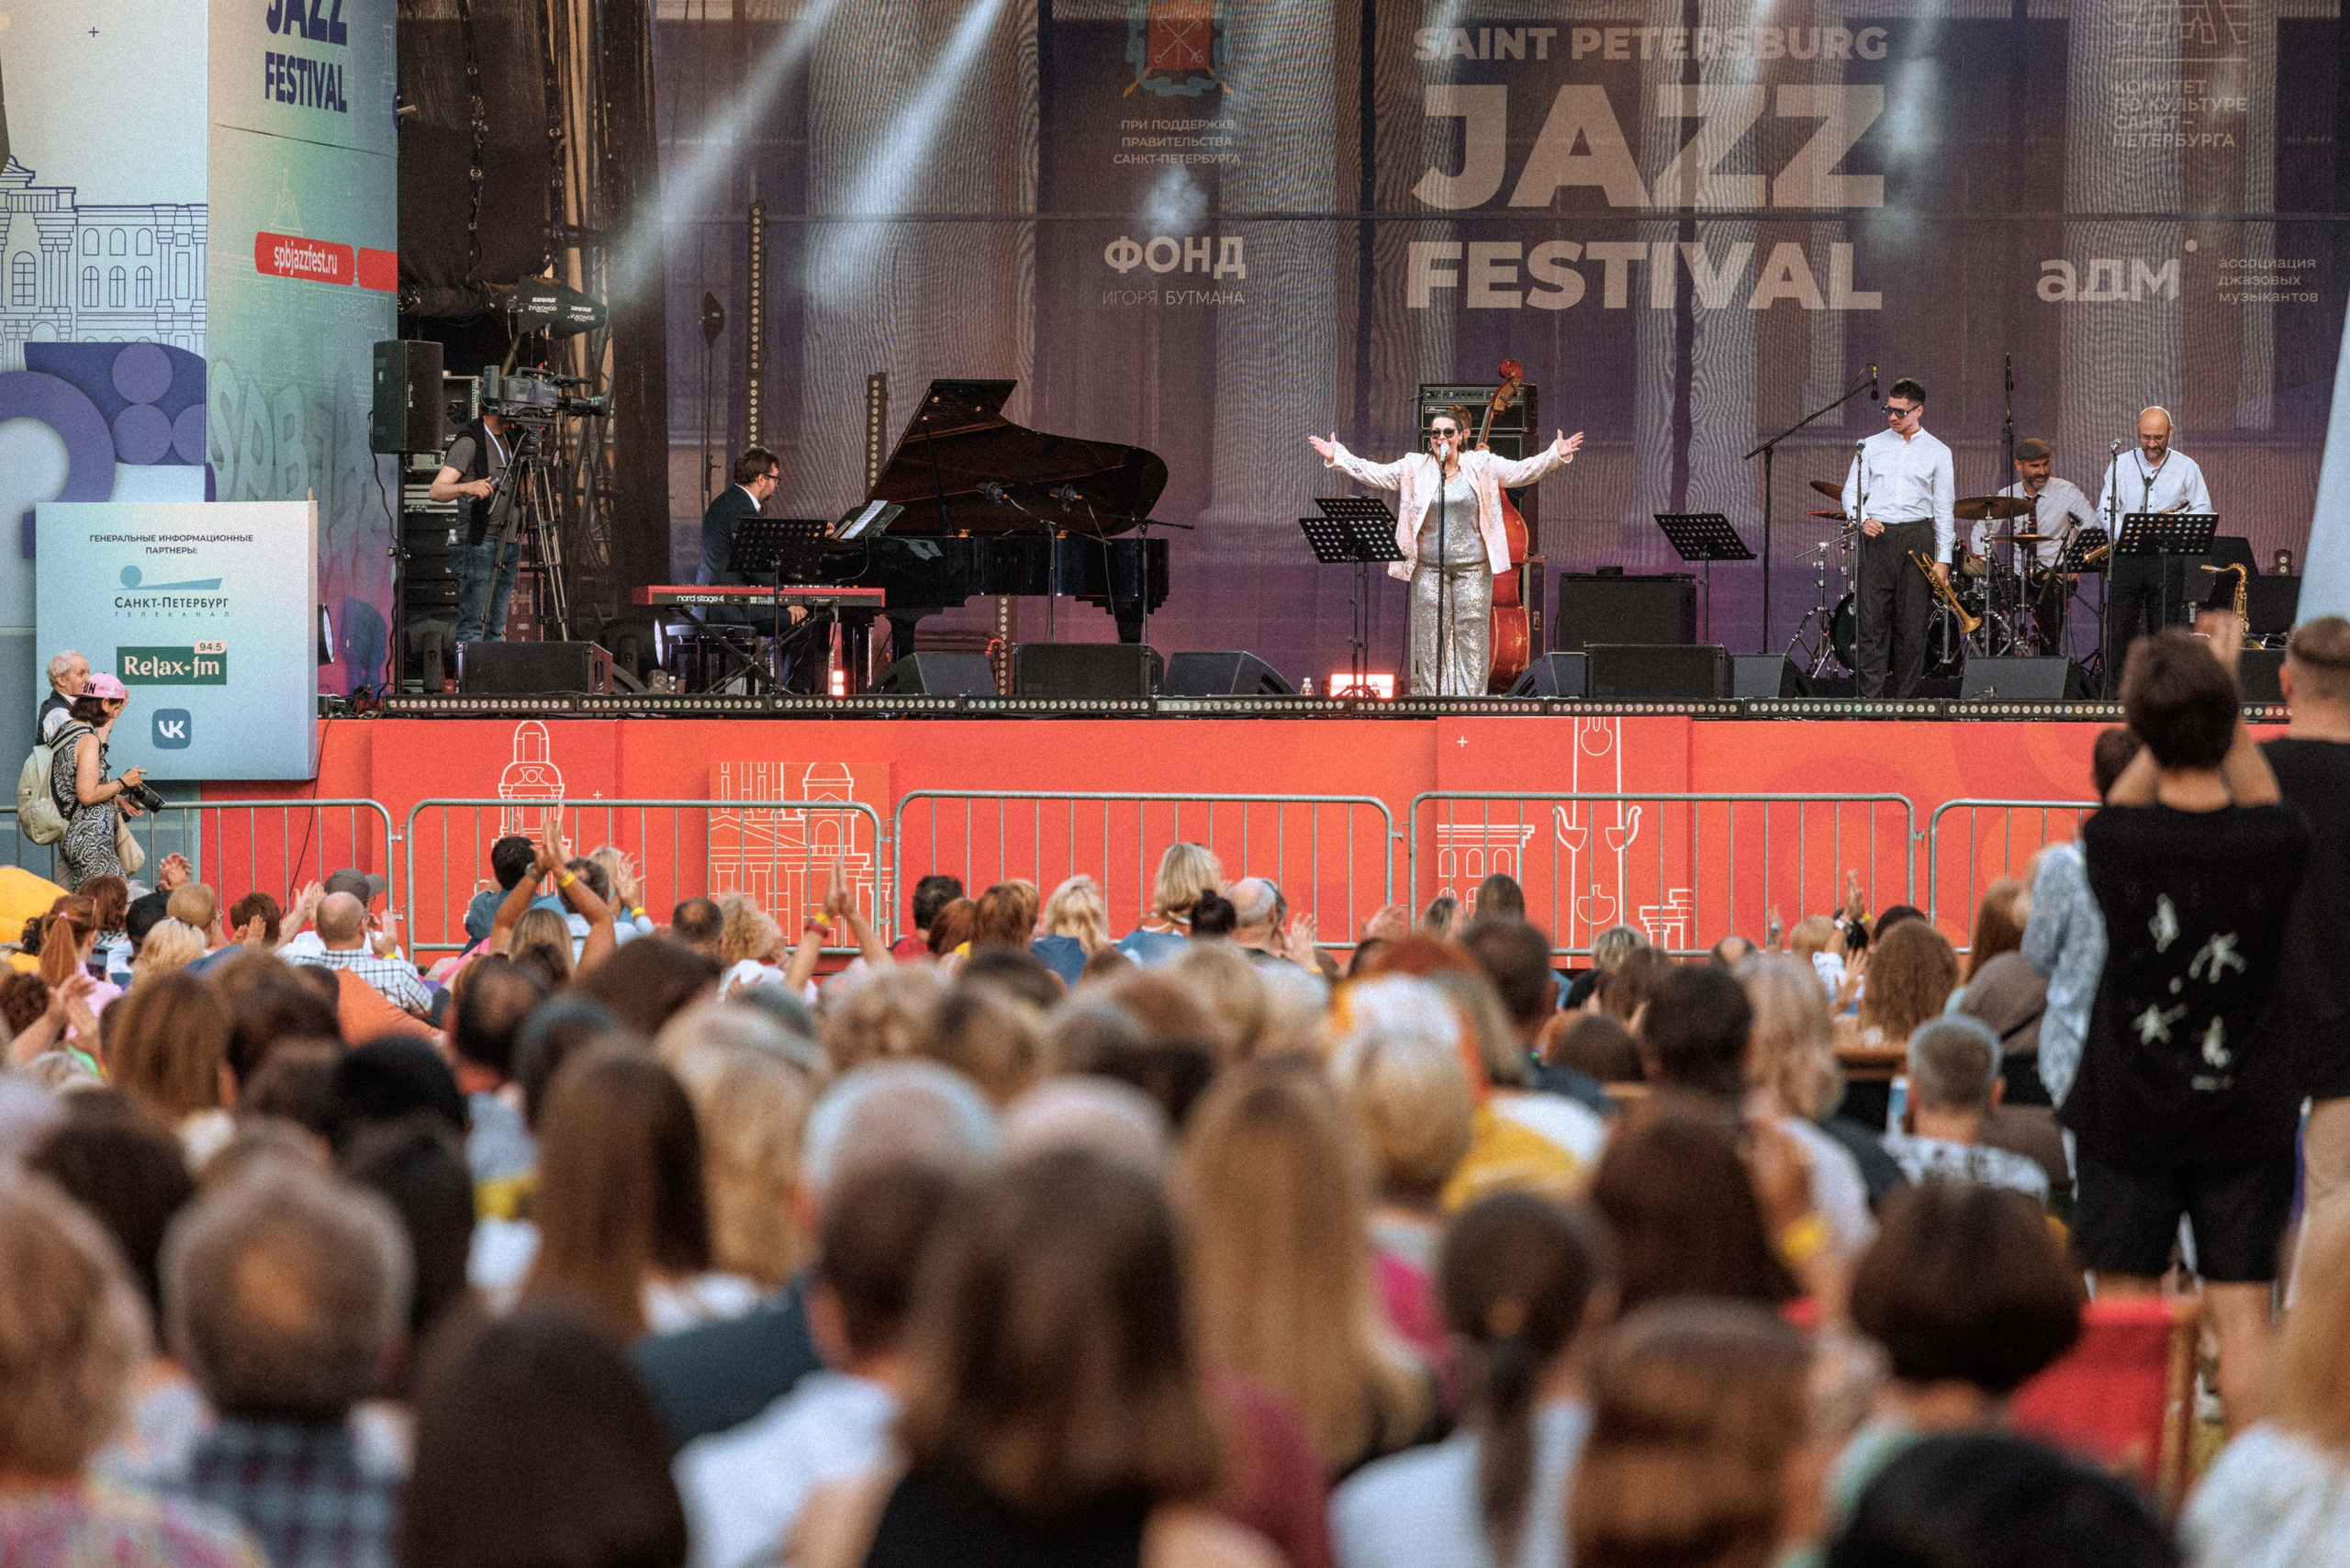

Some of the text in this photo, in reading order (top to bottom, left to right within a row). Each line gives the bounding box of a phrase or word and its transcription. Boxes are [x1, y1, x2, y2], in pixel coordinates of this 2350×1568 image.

[1413, 27, 1888, 61] SAINT PETERSBURG
[265, 51, 347, 113] FESTIVAL
[2114, 80, 2207, 93] КОМИТЕТ
[2114, 98, 2249, 111] ПО КУЛЬТУРЕ
[1121, 120, 1235, 131] ПРИ ПОДДЕРЖКЕ
[1122, 137, 1233, 147] ПРАВИТЕЛЬСТВА
[2113, 133, 2235, 147] ПЕТЕРБУРГА
[1411, 84, 1884, 210] JAZZ
[1113, 153, 1240, 164] САНКТ-ПЕТЕРБУРГА
[274, 240, 338, 275] spbjazzfest.ru
[1104, 236, 1246, 279] ФОНД
[2219, 258, 2317, 269] ассоциация
[1407, 240, 1882, 310] FESTIVAL
[2219, 276, 2301, 286] джазовых
[1103, 290, 1245, 305] ИГОРЯ БУТМАНА
[2219, 293, 2319, 304] музыкантов
[90, 534, 253, 543] ГЕНЕРАЛЬНЫЕ ИНФОРМАЦИОННЫЕ
[145, 546, 198, 554] ПАРТНЕРЫ:
[677, 594, 695, 602] nord
[696, 595, 718, 603] stage
[199, 643, 222, 651] 94.5
